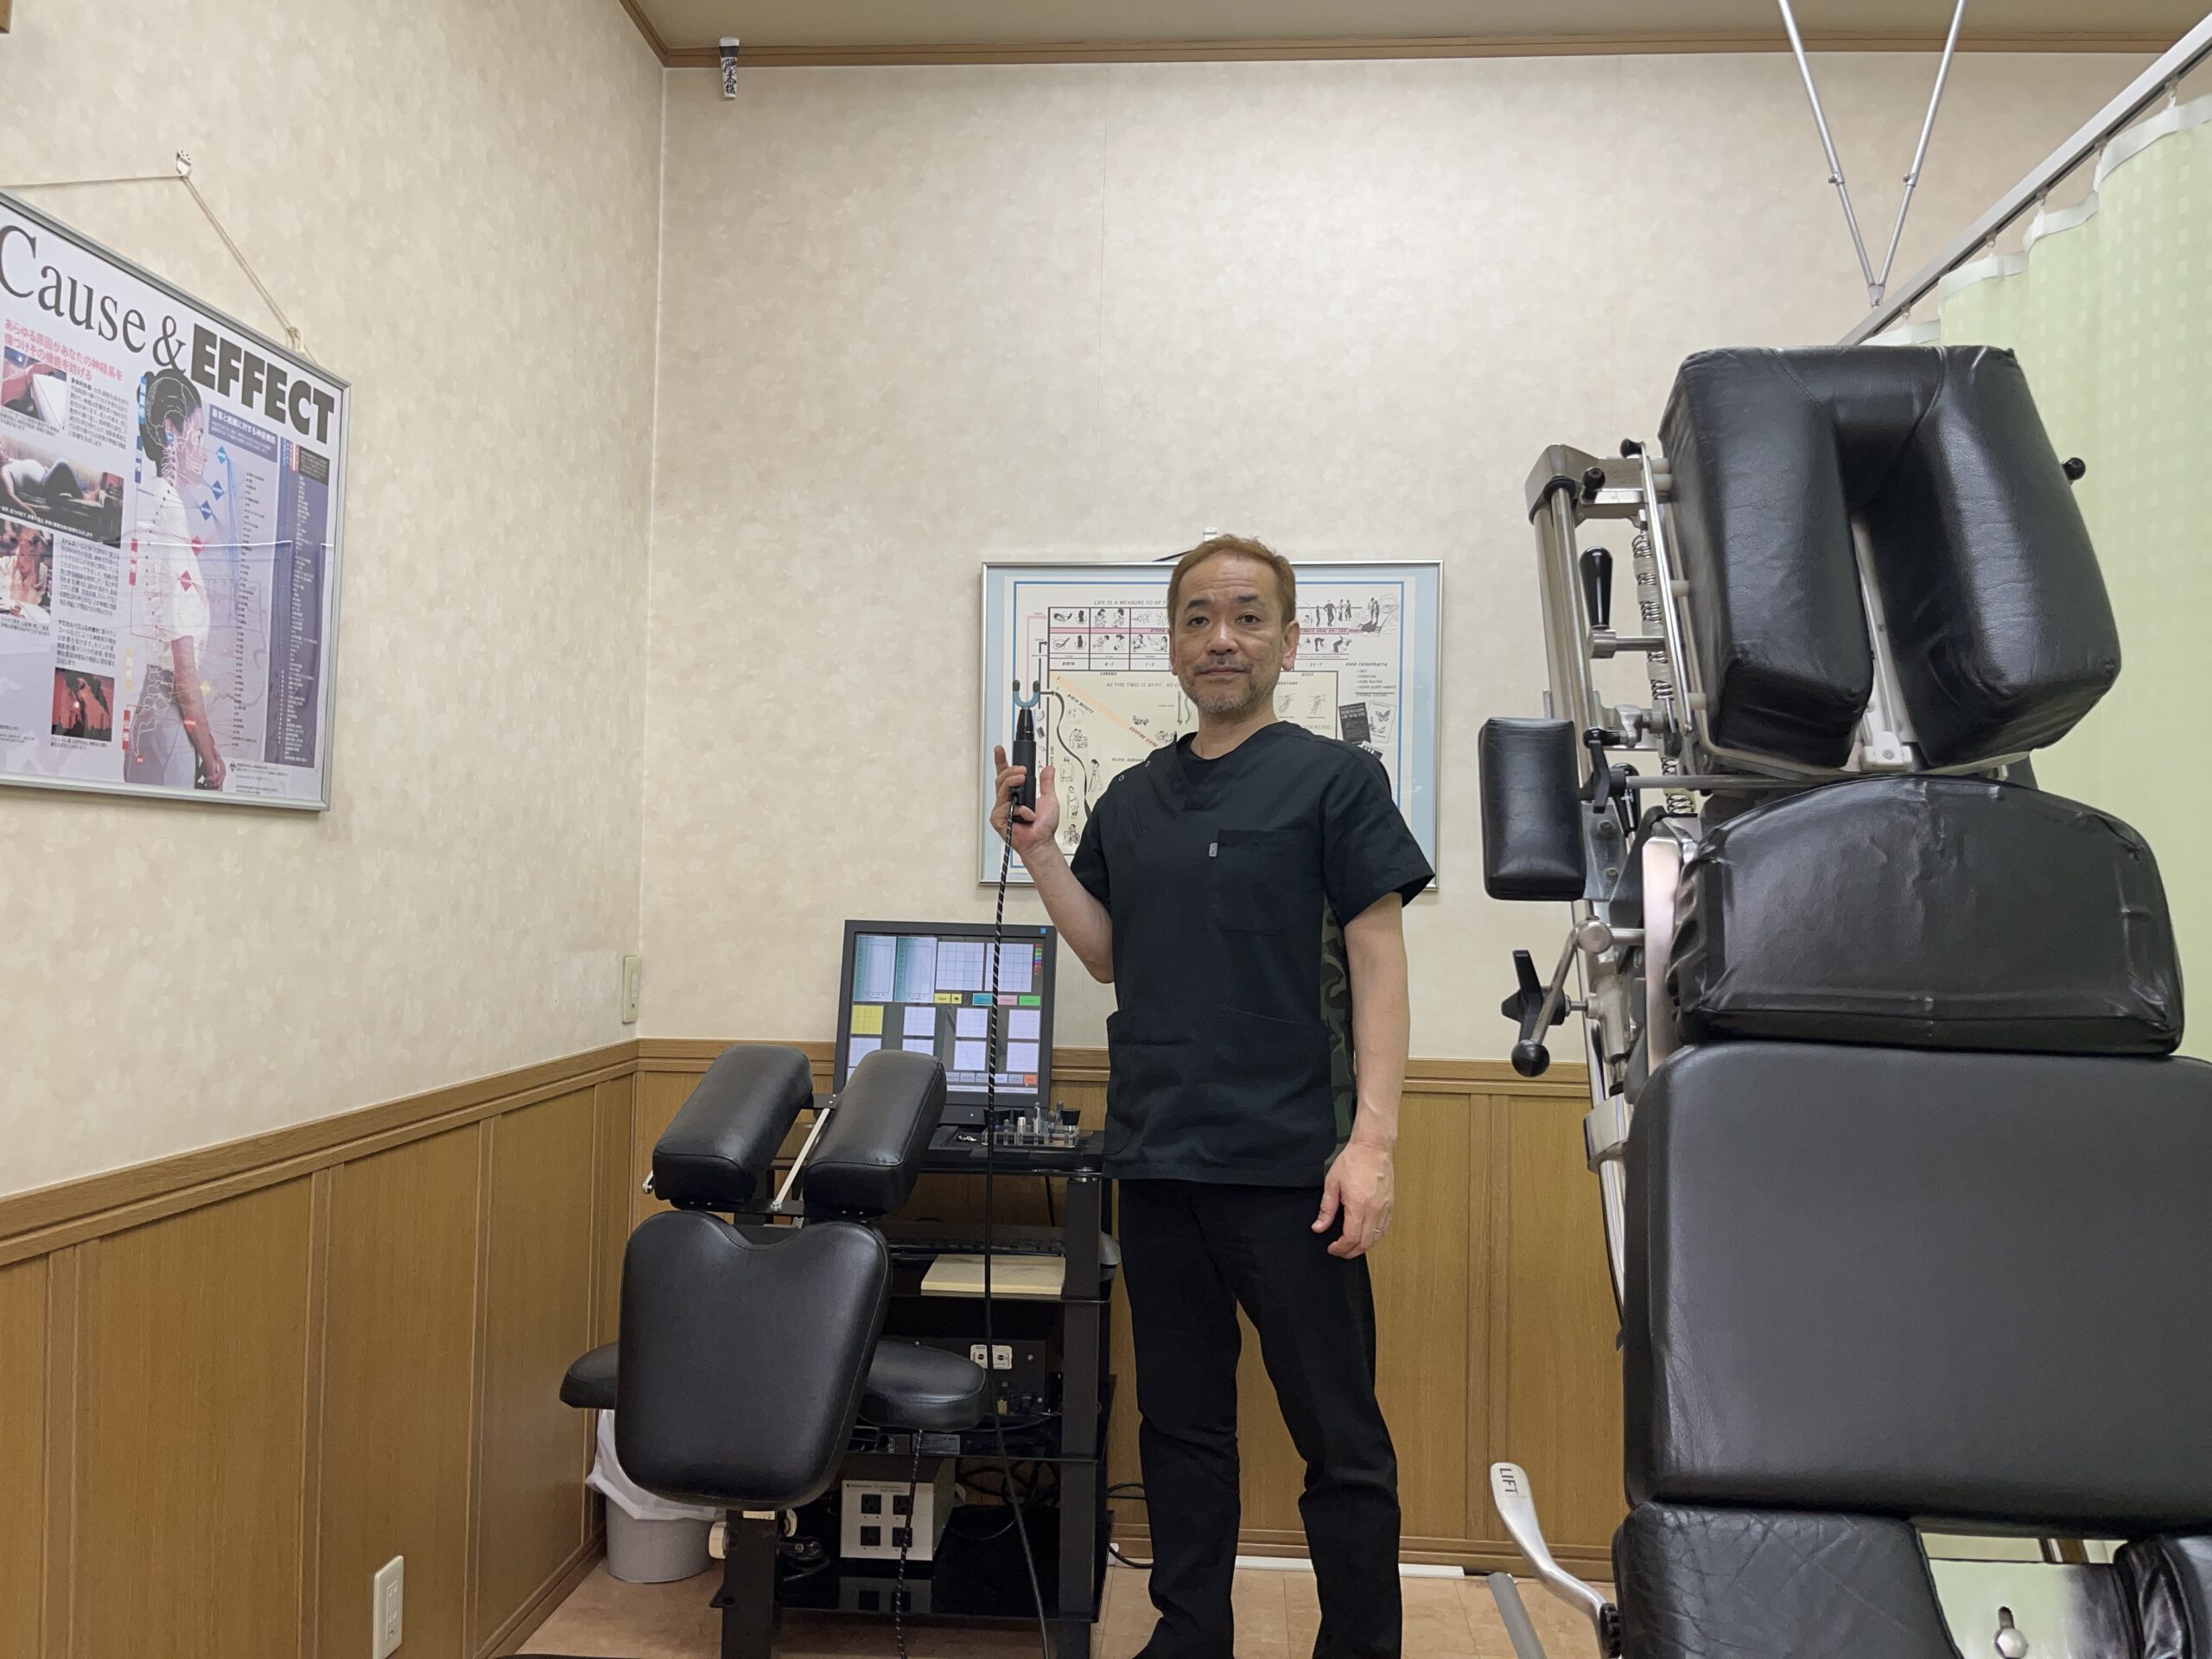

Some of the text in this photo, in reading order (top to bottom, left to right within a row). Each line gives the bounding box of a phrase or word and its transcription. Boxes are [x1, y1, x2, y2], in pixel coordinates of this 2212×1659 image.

[0, 226, 146, 353] Cause
[152, 315, 187, 372] &
[191, 323, 335, 446] EFFECT
[1498, 1467, 1518, 1495] LIFT
